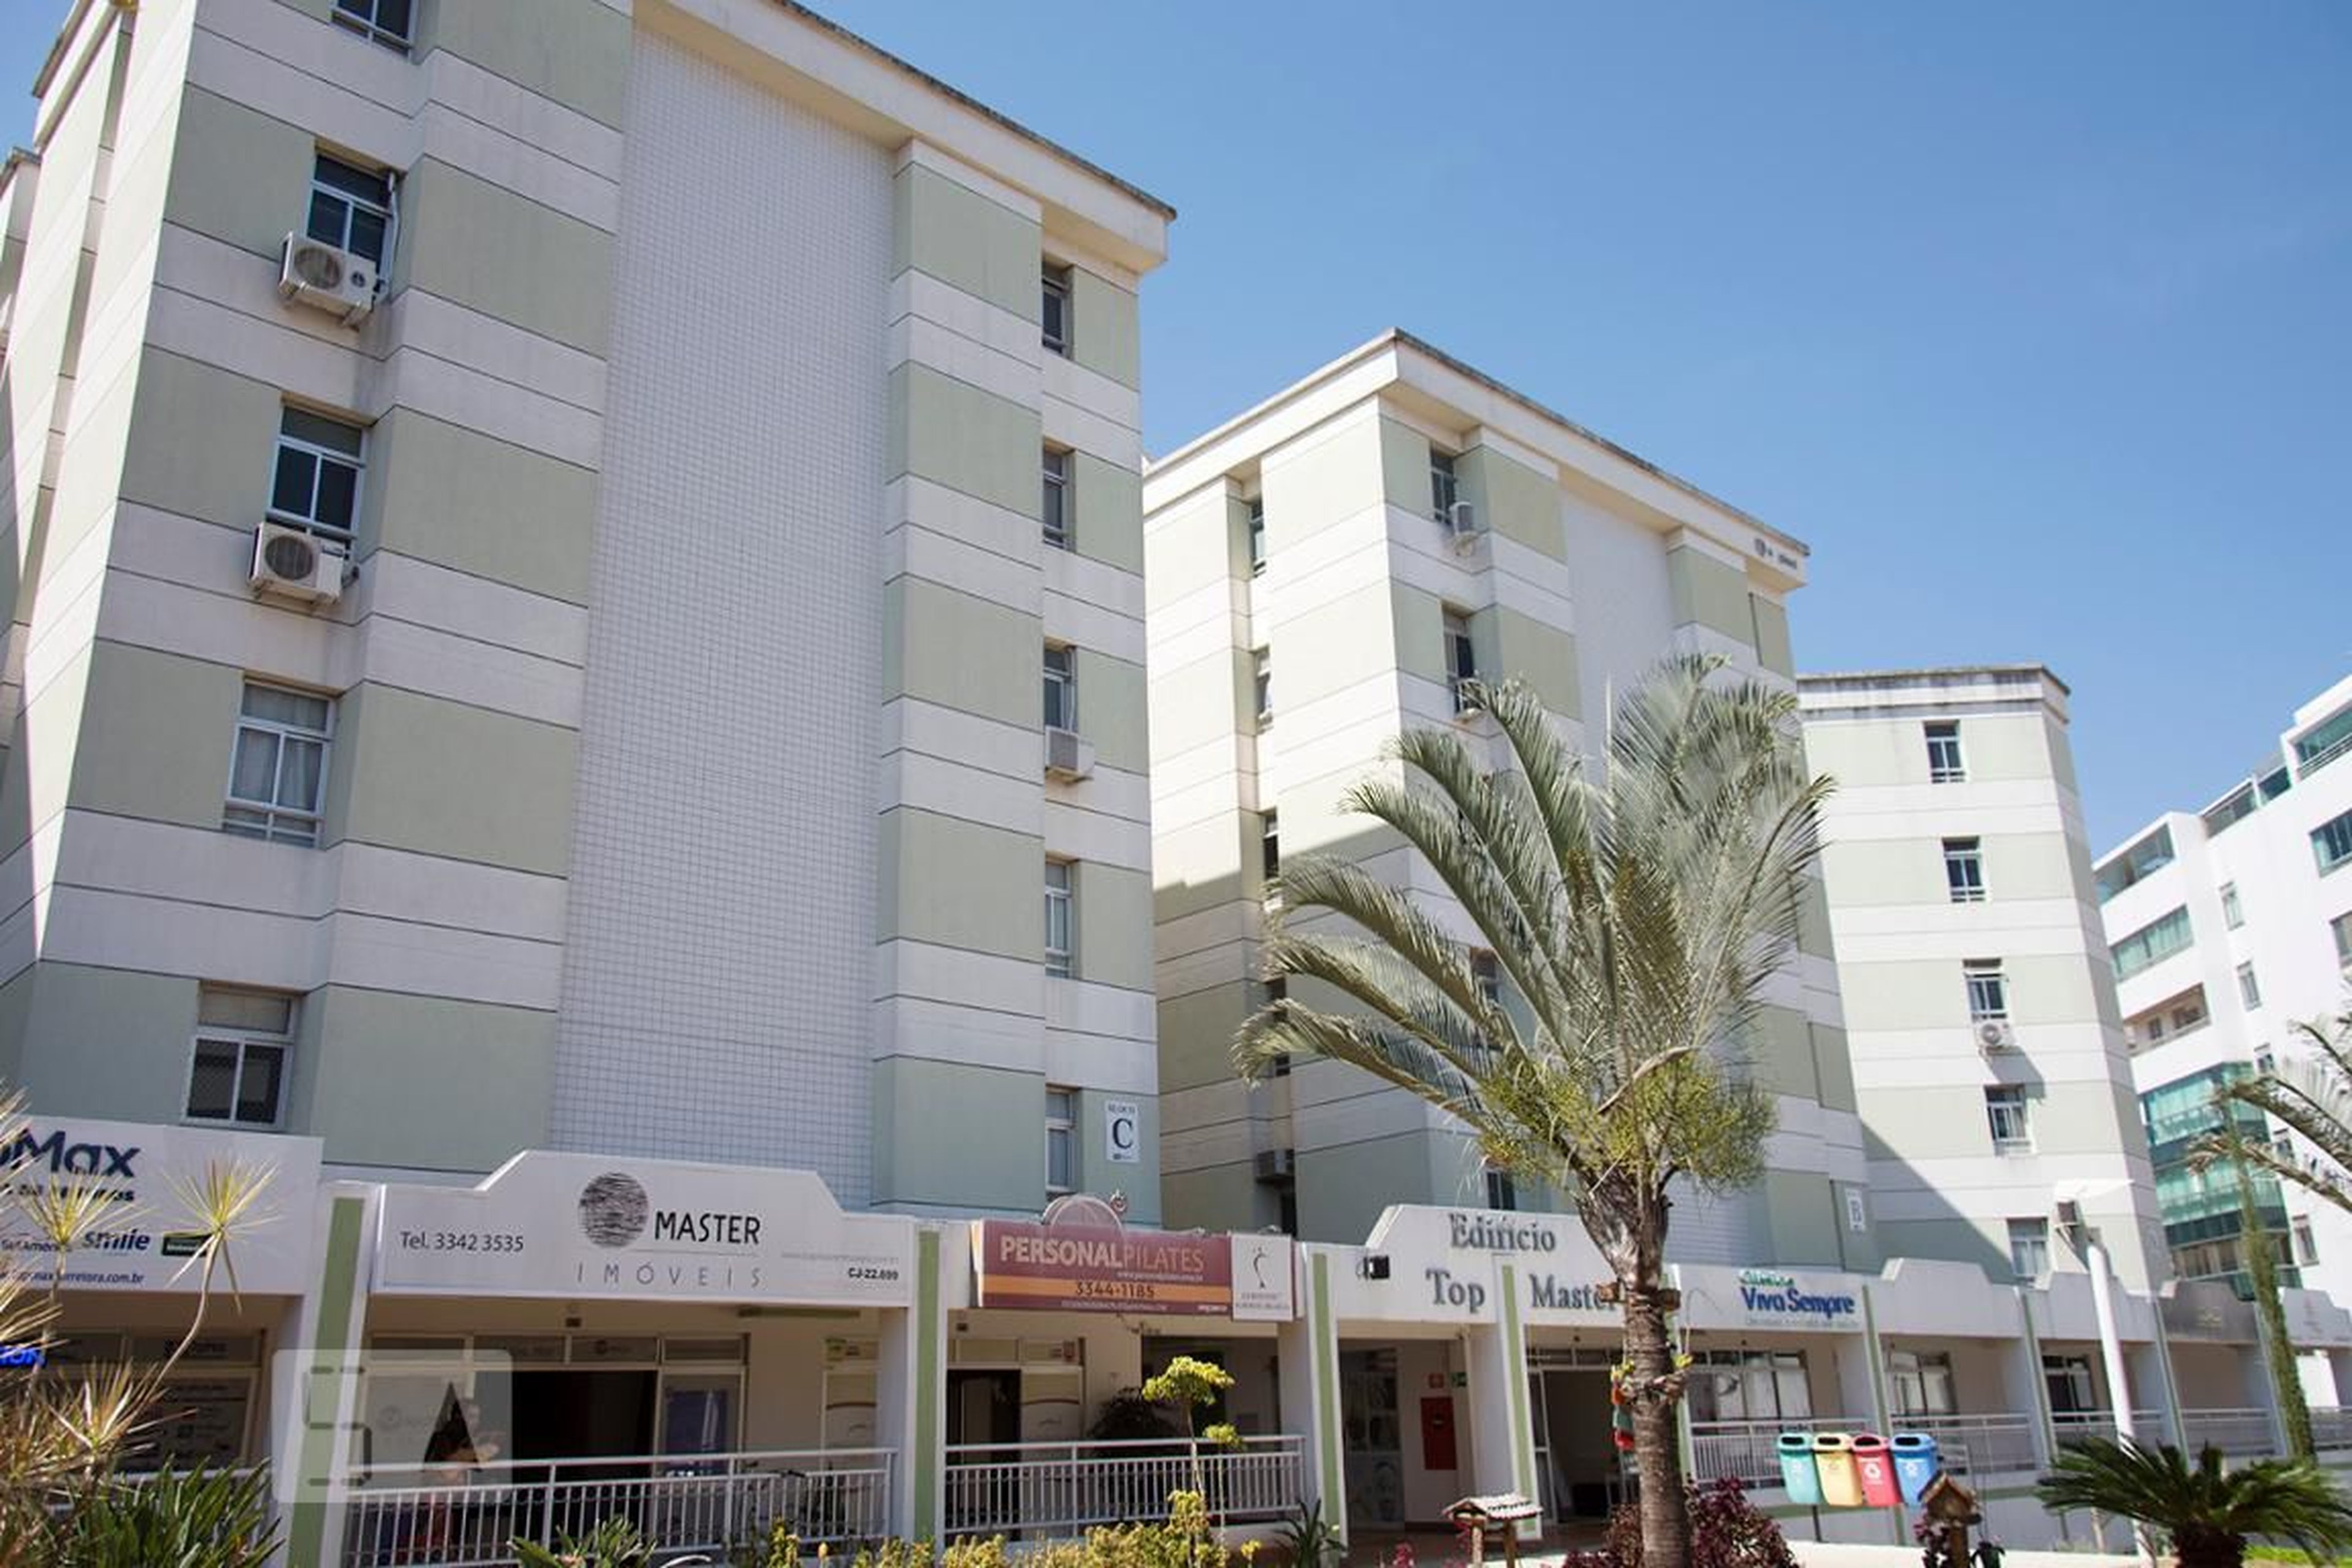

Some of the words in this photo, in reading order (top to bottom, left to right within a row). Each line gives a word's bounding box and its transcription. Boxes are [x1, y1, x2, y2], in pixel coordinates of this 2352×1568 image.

[1112, 1118, 1133, 1150] C
[399, 1231, 430, 1250] Tel.
[433, 1232, 478, 1251] 3342
[481, 1234, 524, 1253] 3535
[654, 1210, 761, 1245] MASTER
[1425, 1267, 1485, 1314] Top
